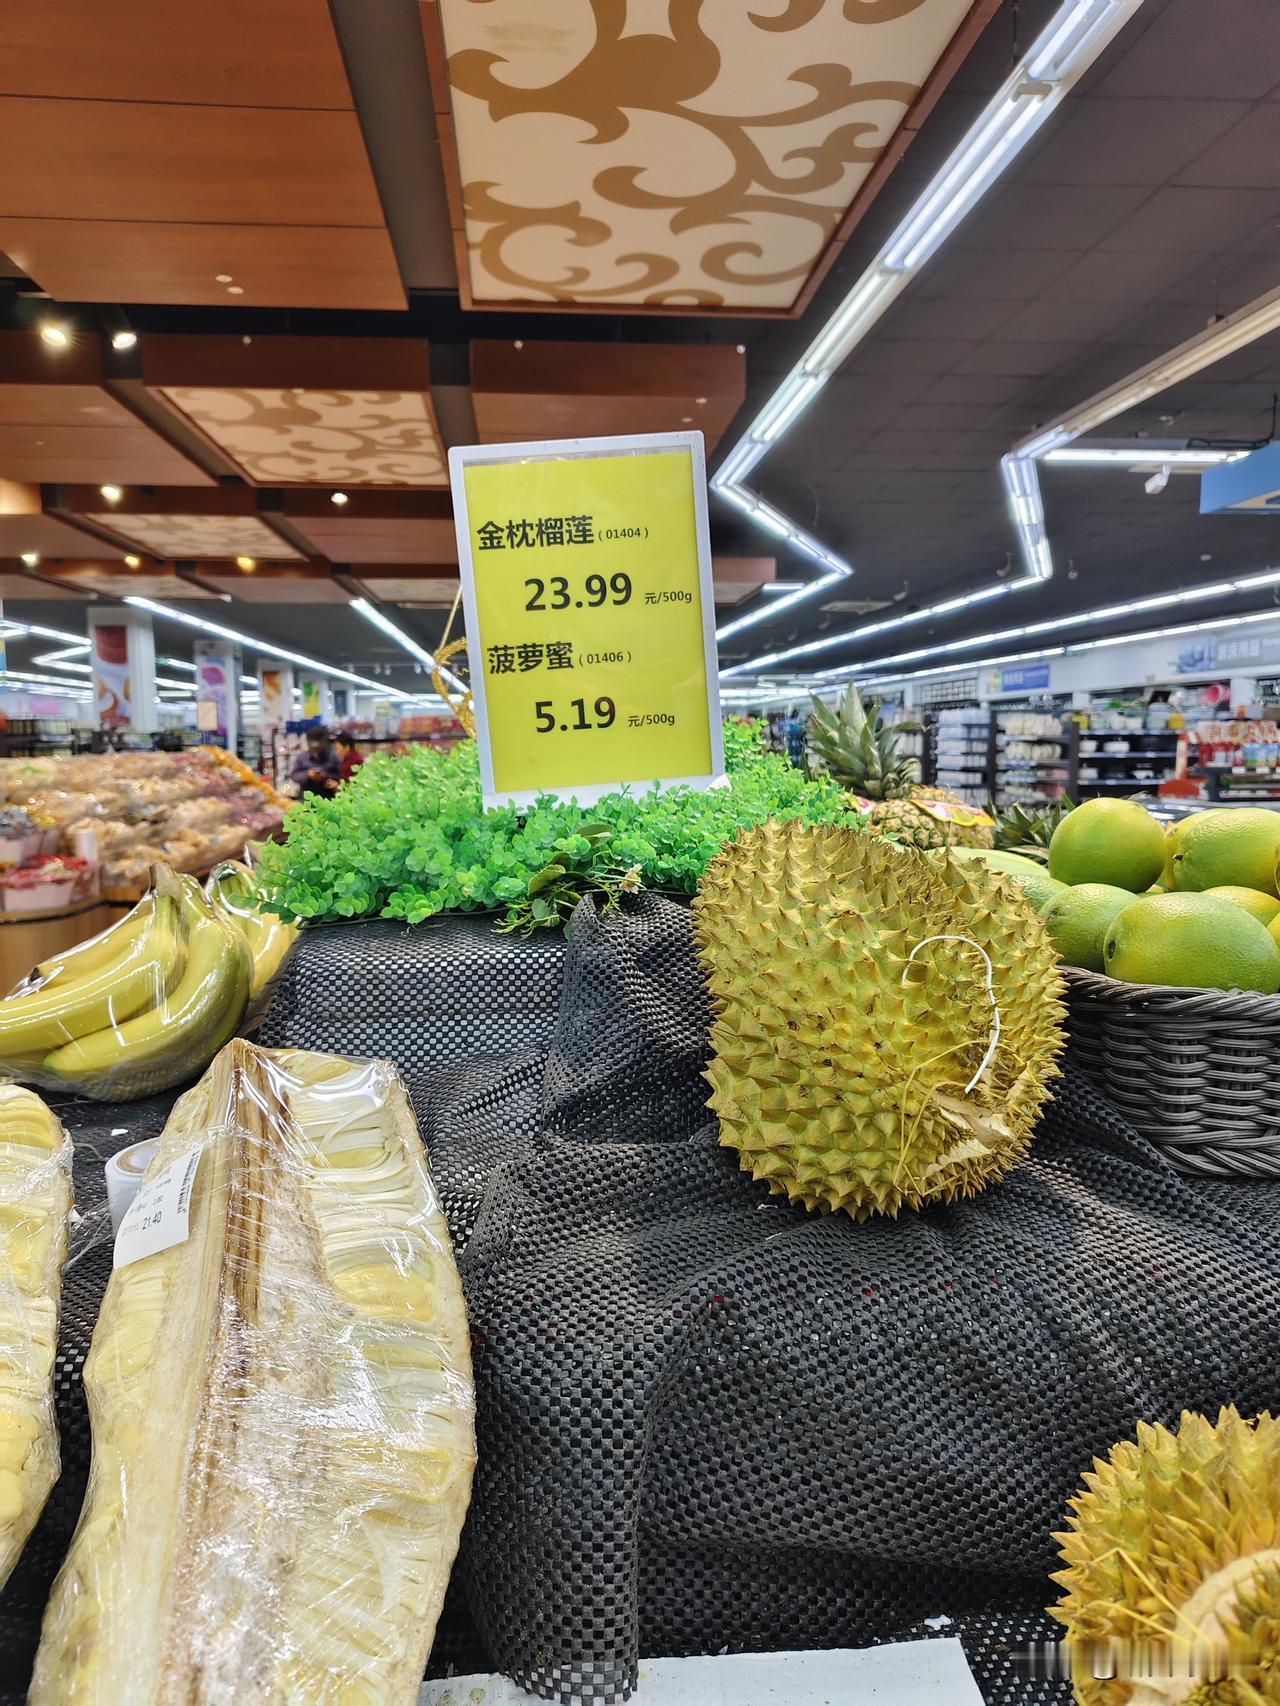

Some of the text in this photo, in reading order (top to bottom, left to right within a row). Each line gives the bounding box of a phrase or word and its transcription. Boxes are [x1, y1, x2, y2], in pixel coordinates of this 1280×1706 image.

[477, 515, 595, 551] 金枕榴莲
[525, 572, 692, 611] 23.99 元/500g
[487, 641, 575, 675] 菠萝蜜
[535, 696, 676, 733] 5.19 元/500g
